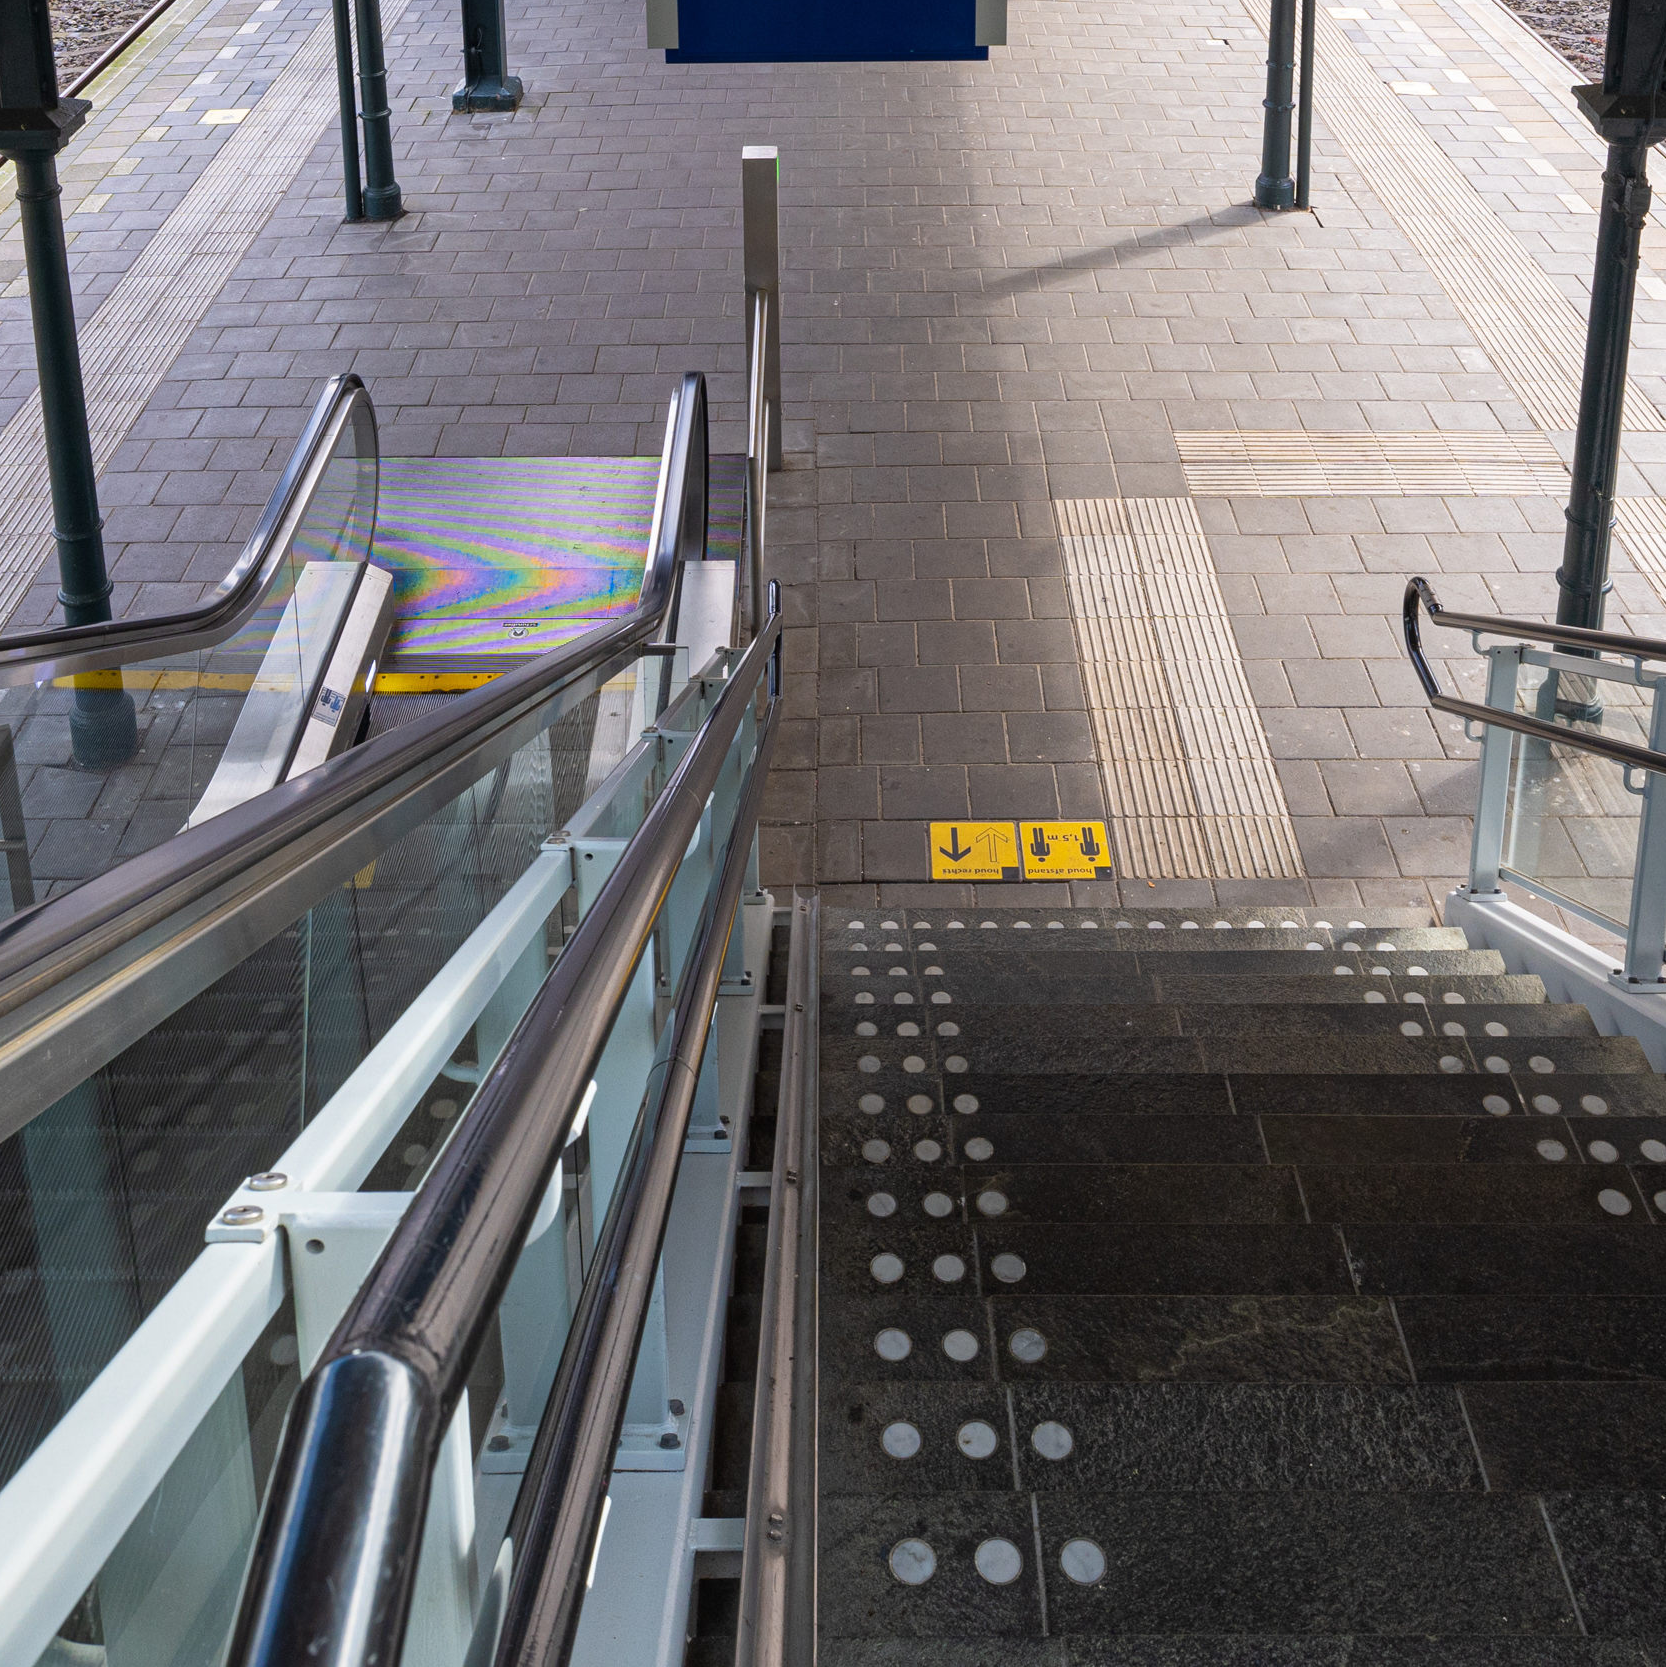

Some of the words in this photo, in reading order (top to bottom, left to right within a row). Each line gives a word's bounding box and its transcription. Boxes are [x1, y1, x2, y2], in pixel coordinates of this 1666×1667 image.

[1062, 833, 1080, 842] 1,5
[942, 867, 972, 875] rechts
[974, 867, 1000, 875] houd
[1027, 867, 1065, 875] afstand
[1067, 867, 1093, 875] houd
